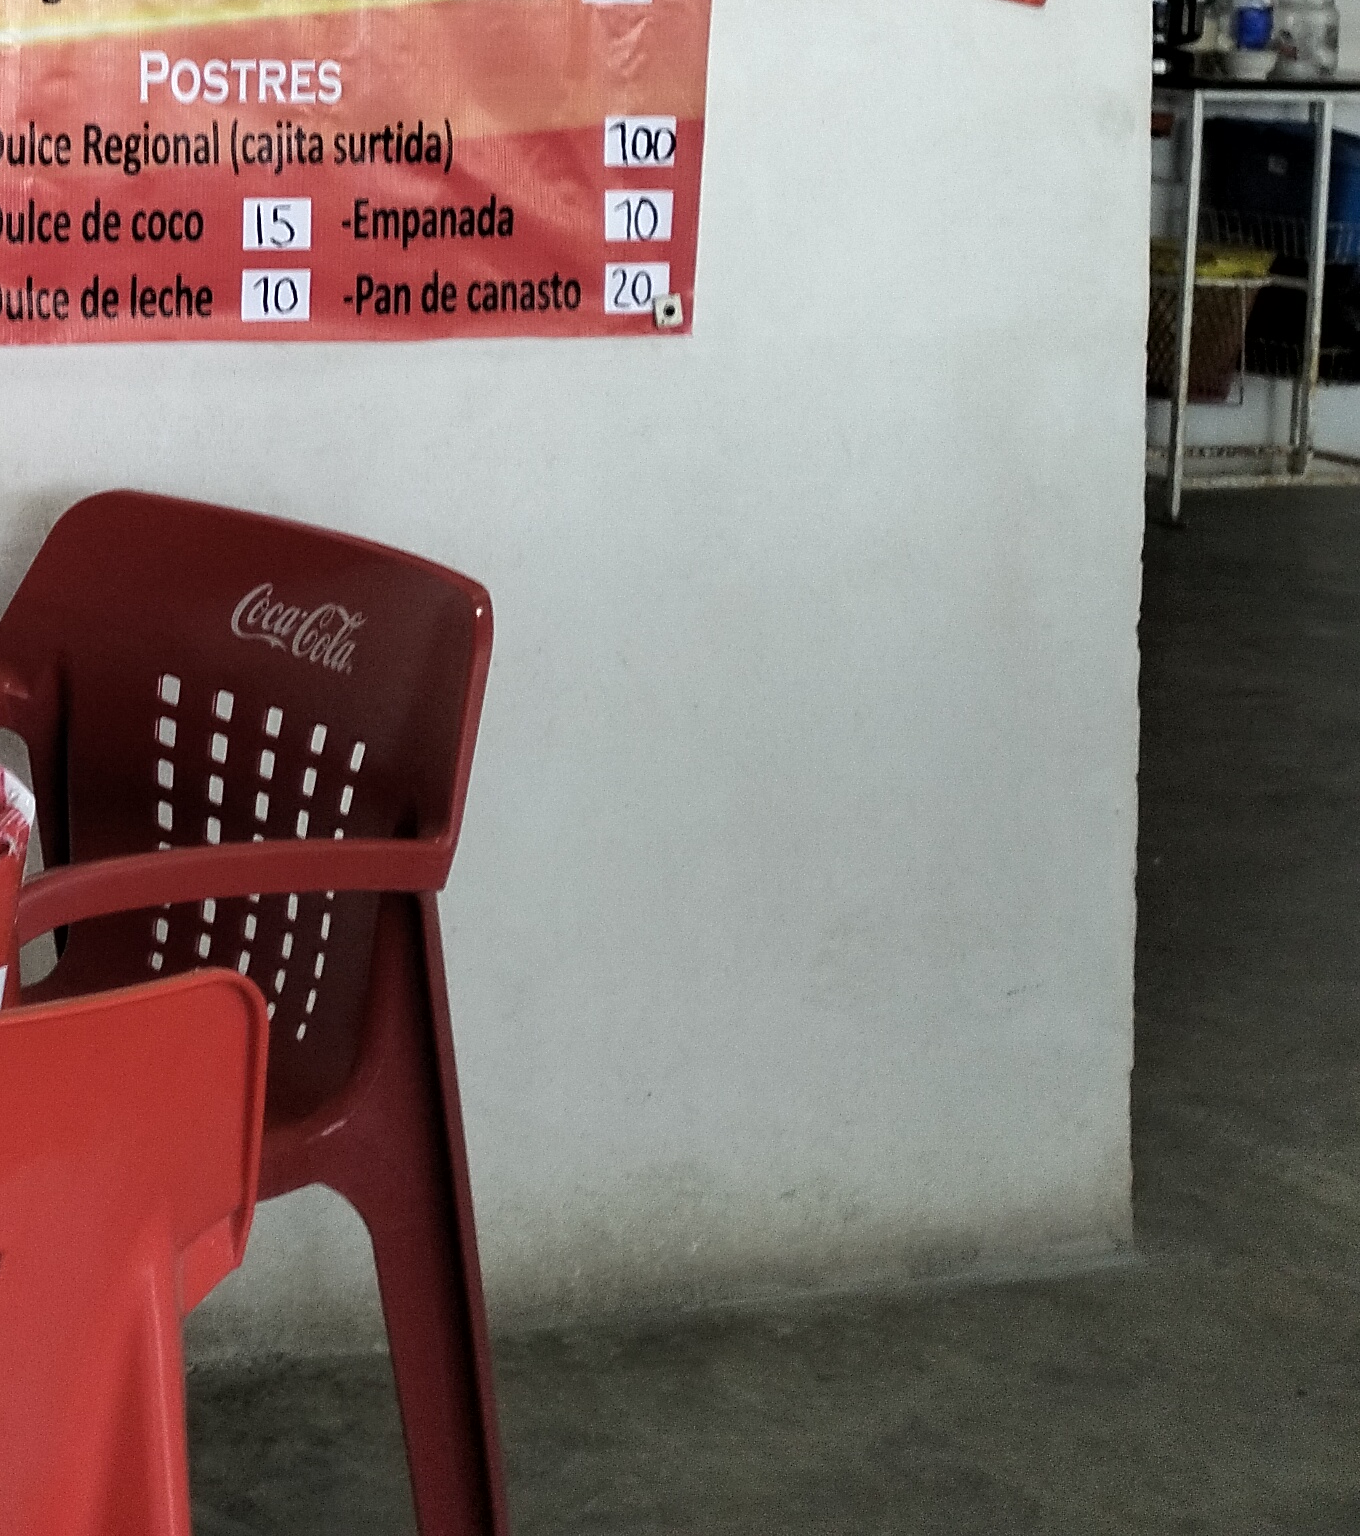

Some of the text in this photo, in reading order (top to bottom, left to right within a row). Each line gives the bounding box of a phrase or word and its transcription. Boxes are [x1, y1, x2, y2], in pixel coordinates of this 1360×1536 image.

[139, 50, 342, 105] POSTRES
[83, 122, 219, 175] Regional
[230, 121, 323, 174] (cajita
[333, 118, 453, 172] surtida)
[610, 122, 676, 163] 100
[81, 200, 120, 242] de
[131, 210, 204, 242] coco
[255, 205, 295, 246] 15
[615, 200, 659, 240] 10
[421, 272, 457, 313] de
[467, 276, 581, 313] canasto
[611, 268, 651, 306] 20
